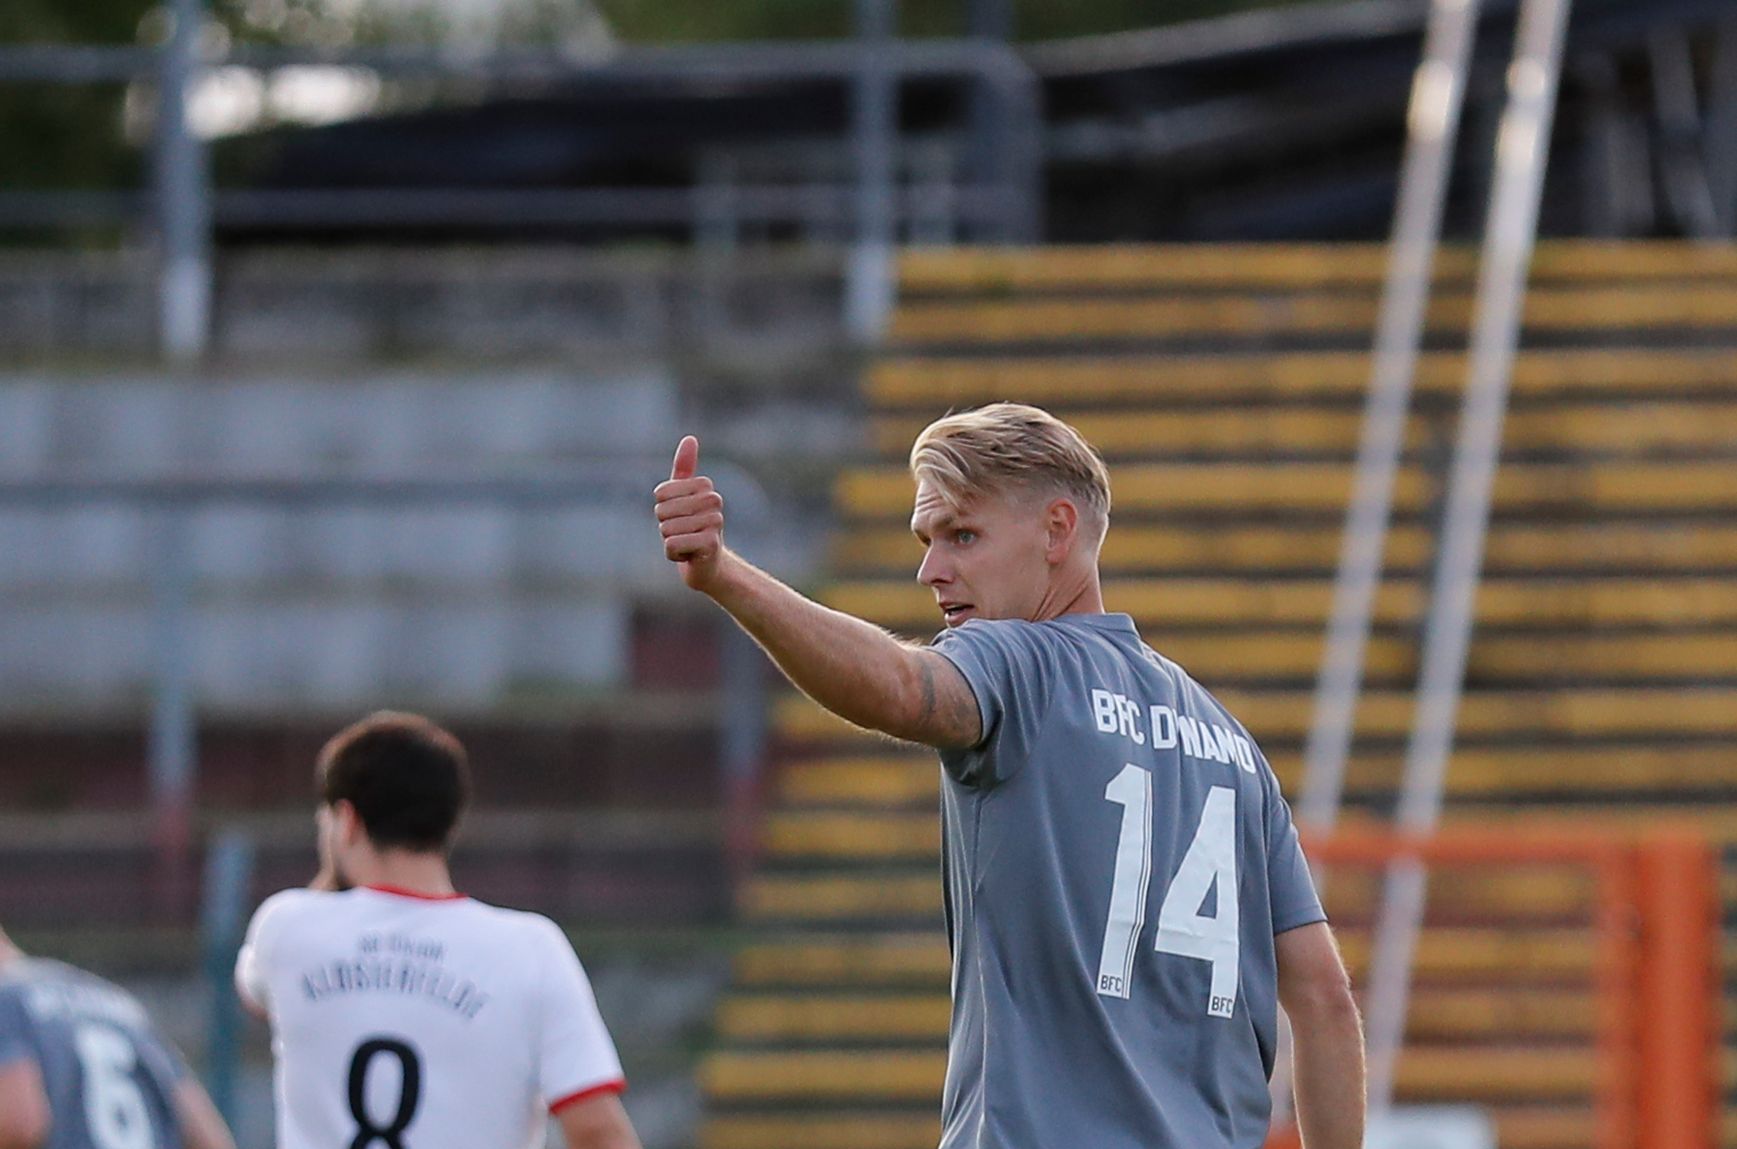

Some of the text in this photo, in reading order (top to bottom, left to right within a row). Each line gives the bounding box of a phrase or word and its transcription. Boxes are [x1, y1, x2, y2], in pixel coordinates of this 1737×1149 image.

[1092, 689, 1256, 774] BFC DNAMO
[1097, 763, 1239, 1018] 14
[1101, 975, 1122, 991] BFC
[1212, 996, 1233, 1013] BFC
